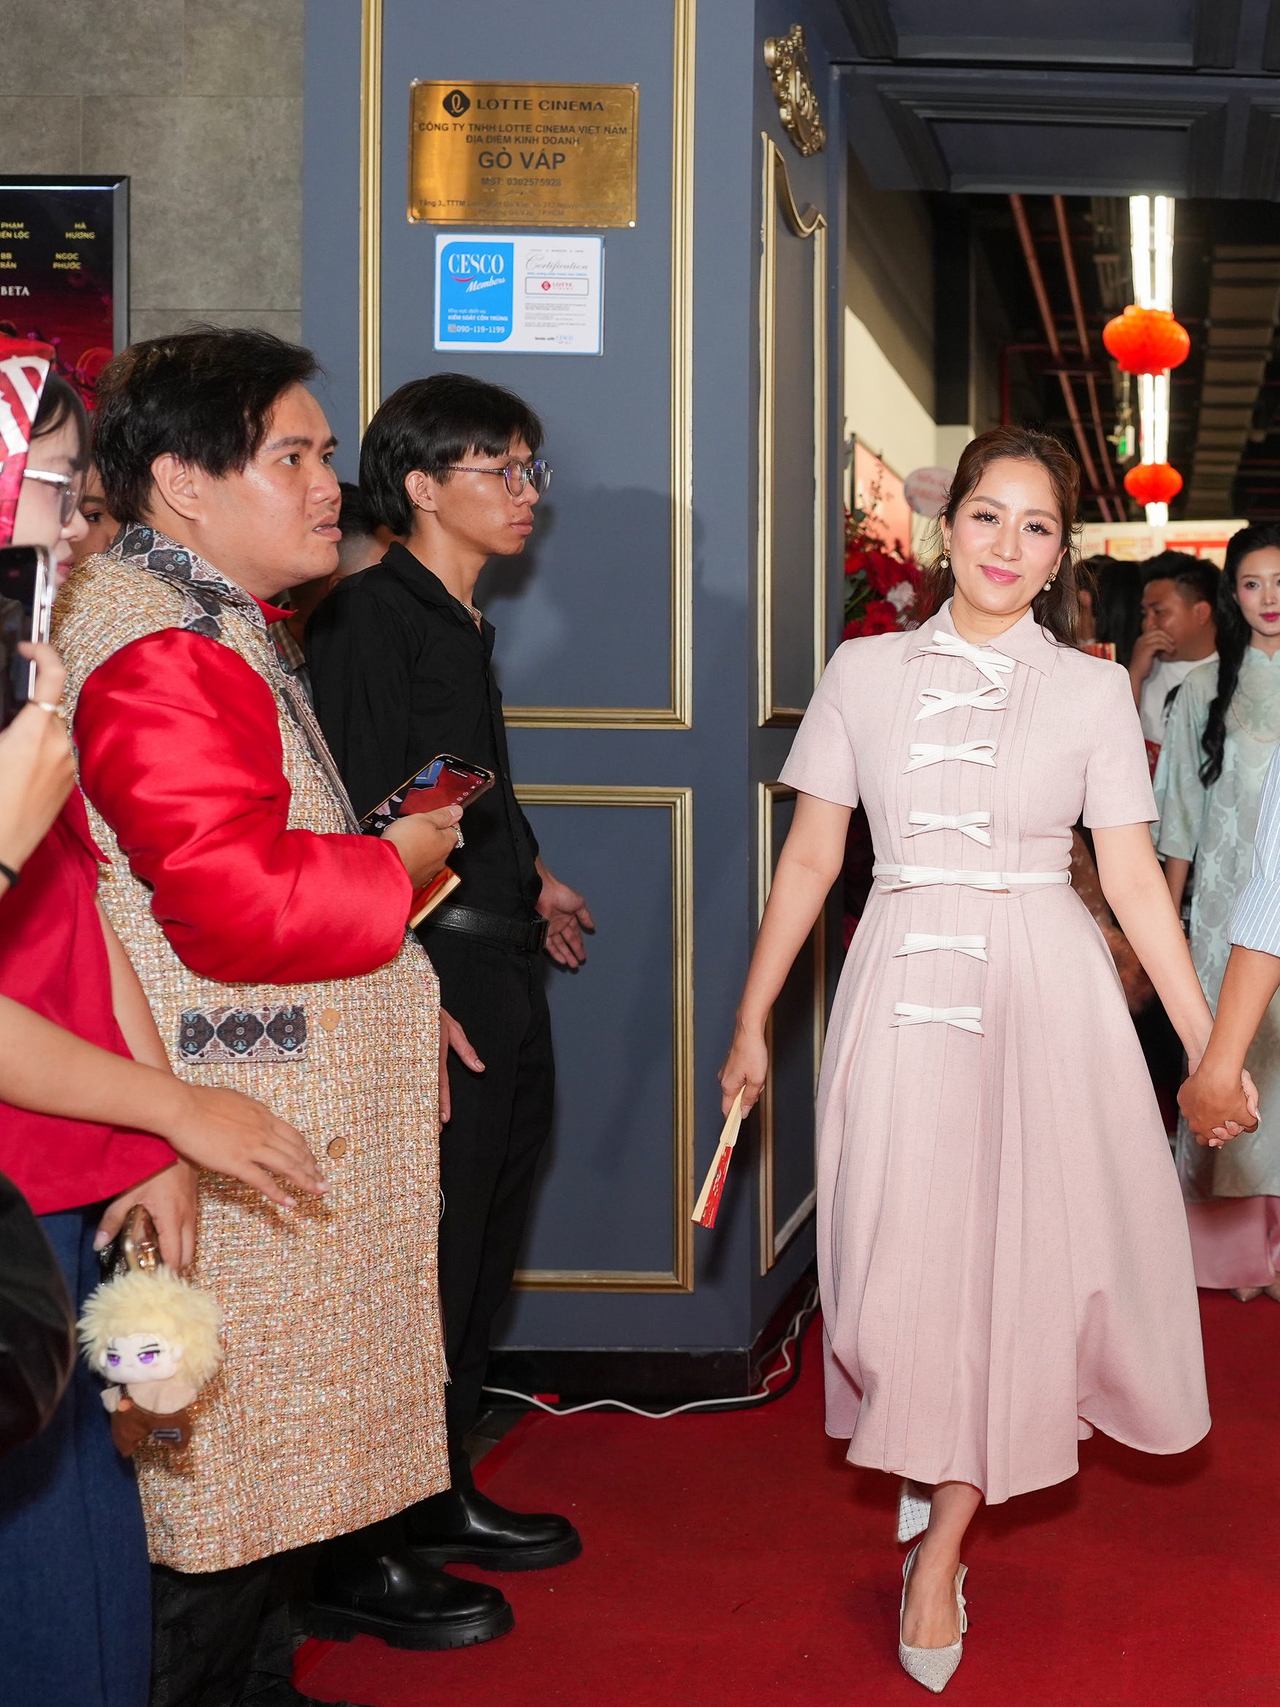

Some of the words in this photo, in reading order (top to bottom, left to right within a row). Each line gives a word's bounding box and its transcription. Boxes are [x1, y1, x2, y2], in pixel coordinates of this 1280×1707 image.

[476, 98, 533, 111] LOTTE
[538, 99, 604, 111] CINEMA
[418, 121, 449, 132] CÔNG
[452, 123, 465, 132] TY
[469, 123, 496, 132] TNHH
[499, 123, 533, 133] LOTTE
[535, 124, 576, 134] CINEMA
[603, 125, 628, 135] NAM
[514, 135, 540, 145] KINH
[542, 136, 581, 146] DOANH
[478, 147, 513, 169] GÒ
[448, 253, 505, 275] CESCO
[525, 253, 588, 272] Certification
[1, 285, 31, 297] BETA
